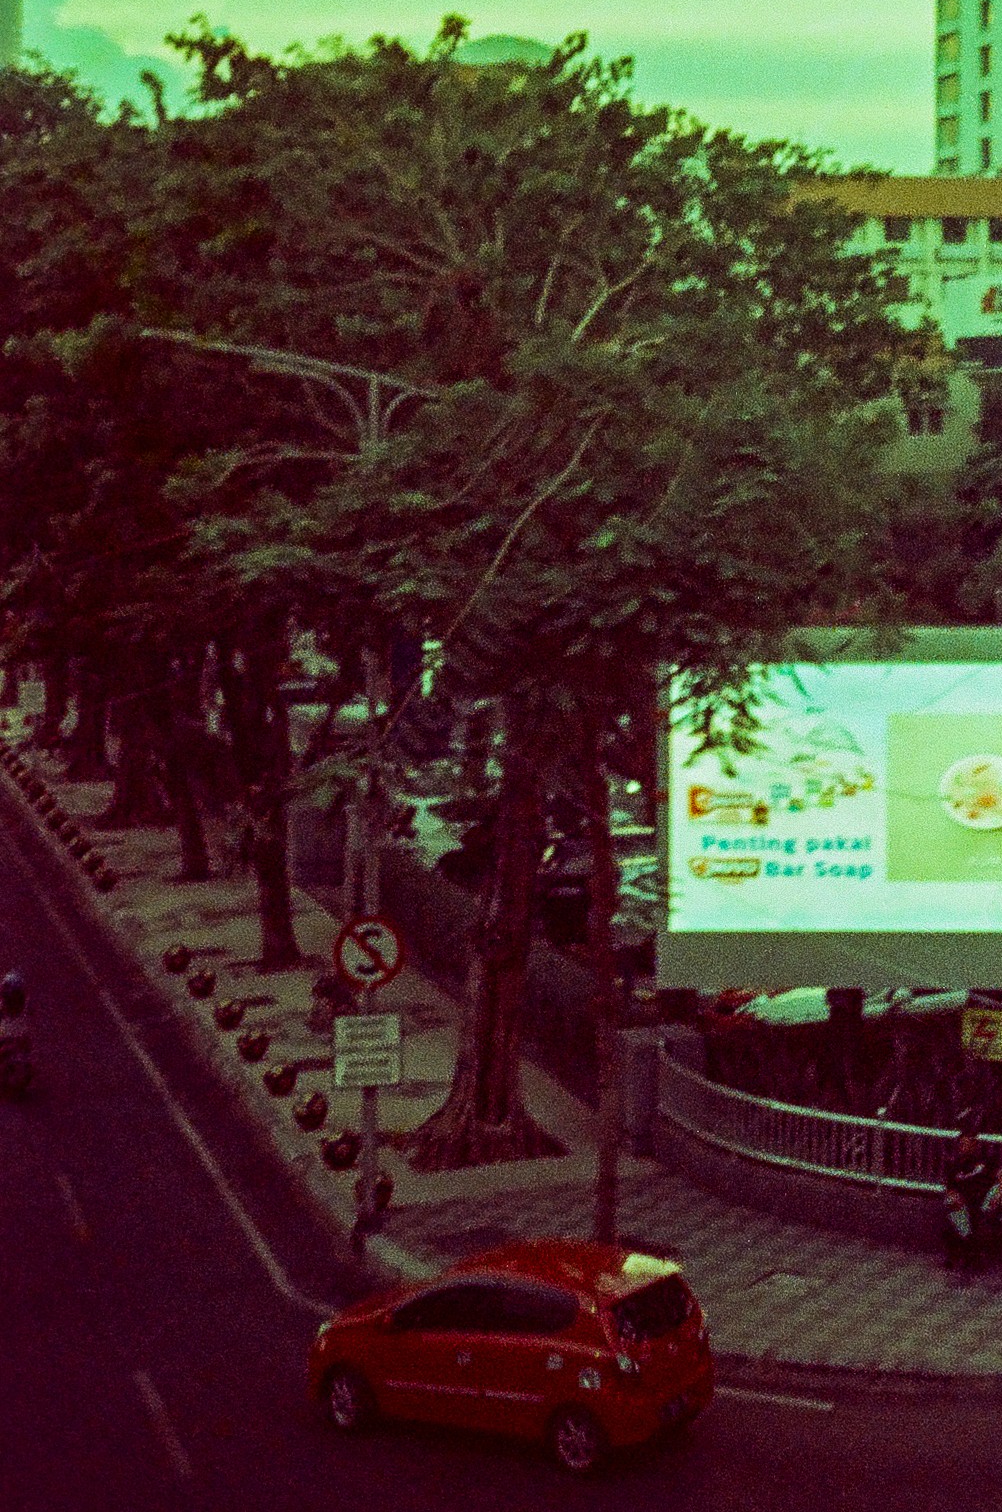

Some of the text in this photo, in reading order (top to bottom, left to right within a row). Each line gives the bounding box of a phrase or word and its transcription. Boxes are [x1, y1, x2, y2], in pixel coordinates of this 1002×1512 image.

[702, 835, 871, 854] Penting pakai
[765, 861, 803, 877] Bar
[815, 861, 872, 879] Soap
